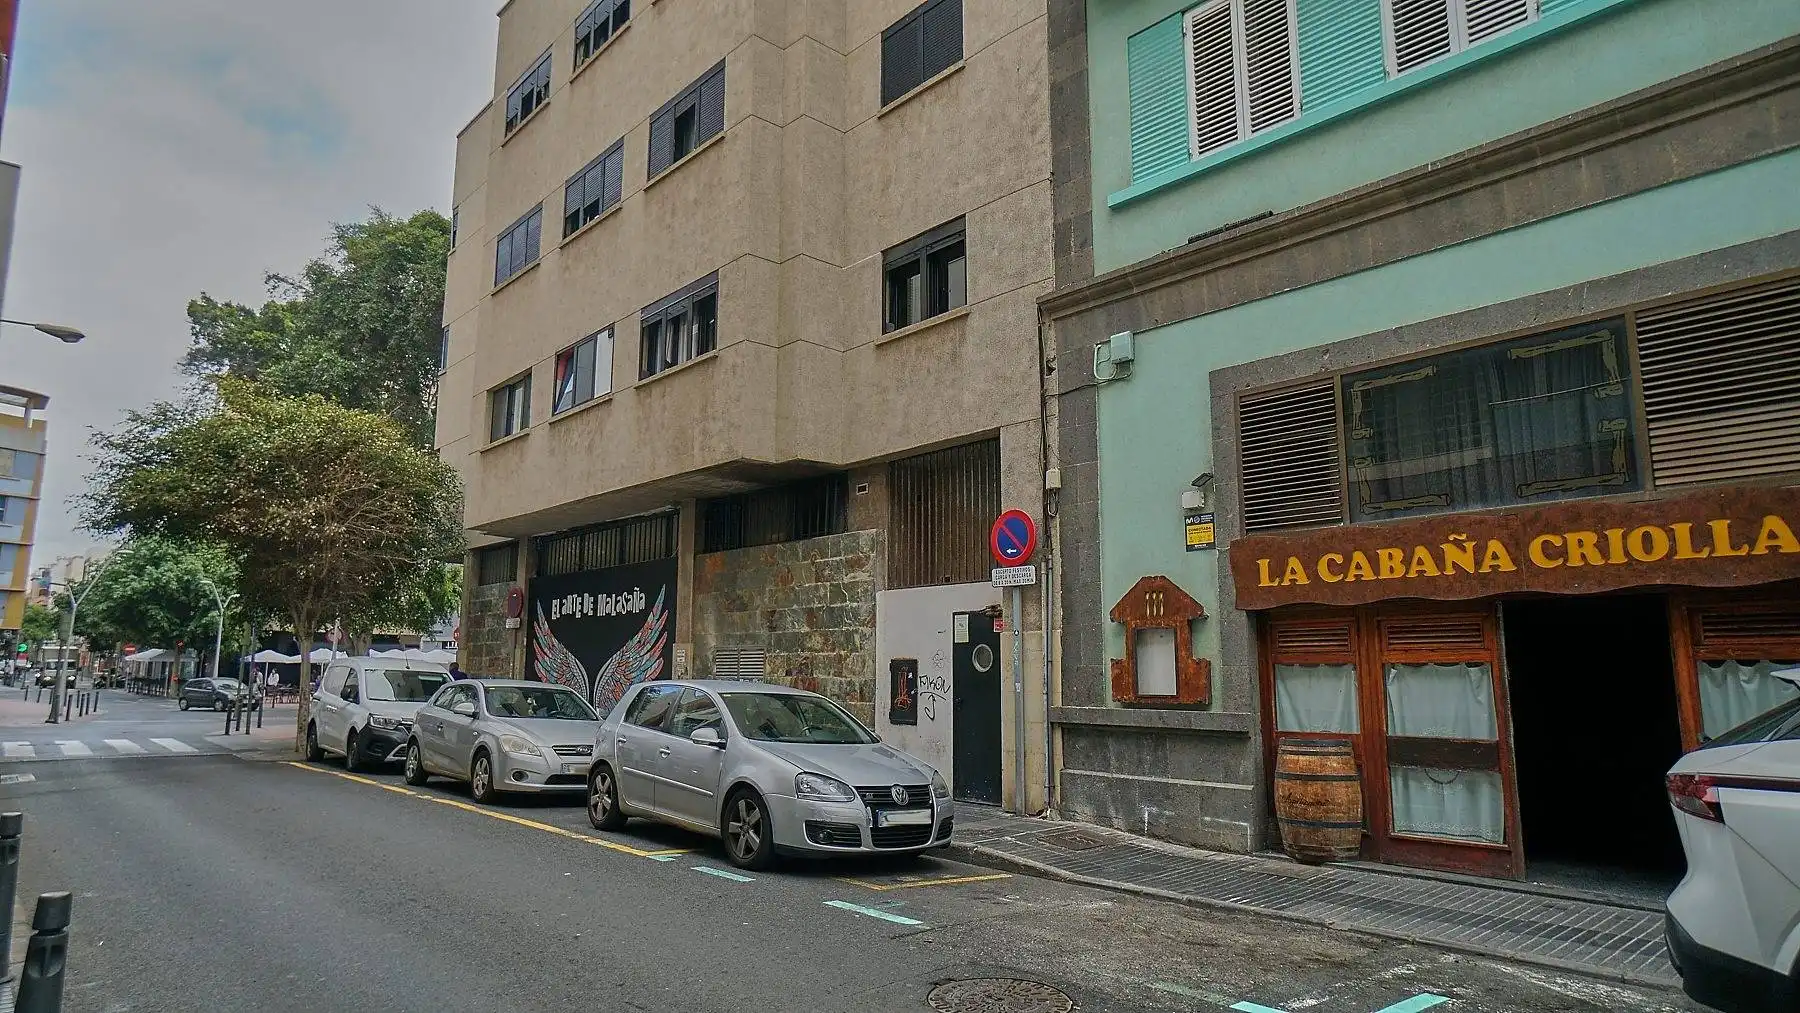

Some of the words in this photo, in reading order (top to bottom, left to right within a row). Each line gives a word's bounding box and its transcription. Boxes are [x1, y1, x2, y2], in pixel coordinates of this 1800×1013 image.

[1256, 556, 1311, 587] LA
[1317, 532, 1517, 583] CABAÑA
[1528, 514, 1800, 569] CRIOLLA
[552, 599, 560, 619] EL
[583, 593, 594, 616] DE
